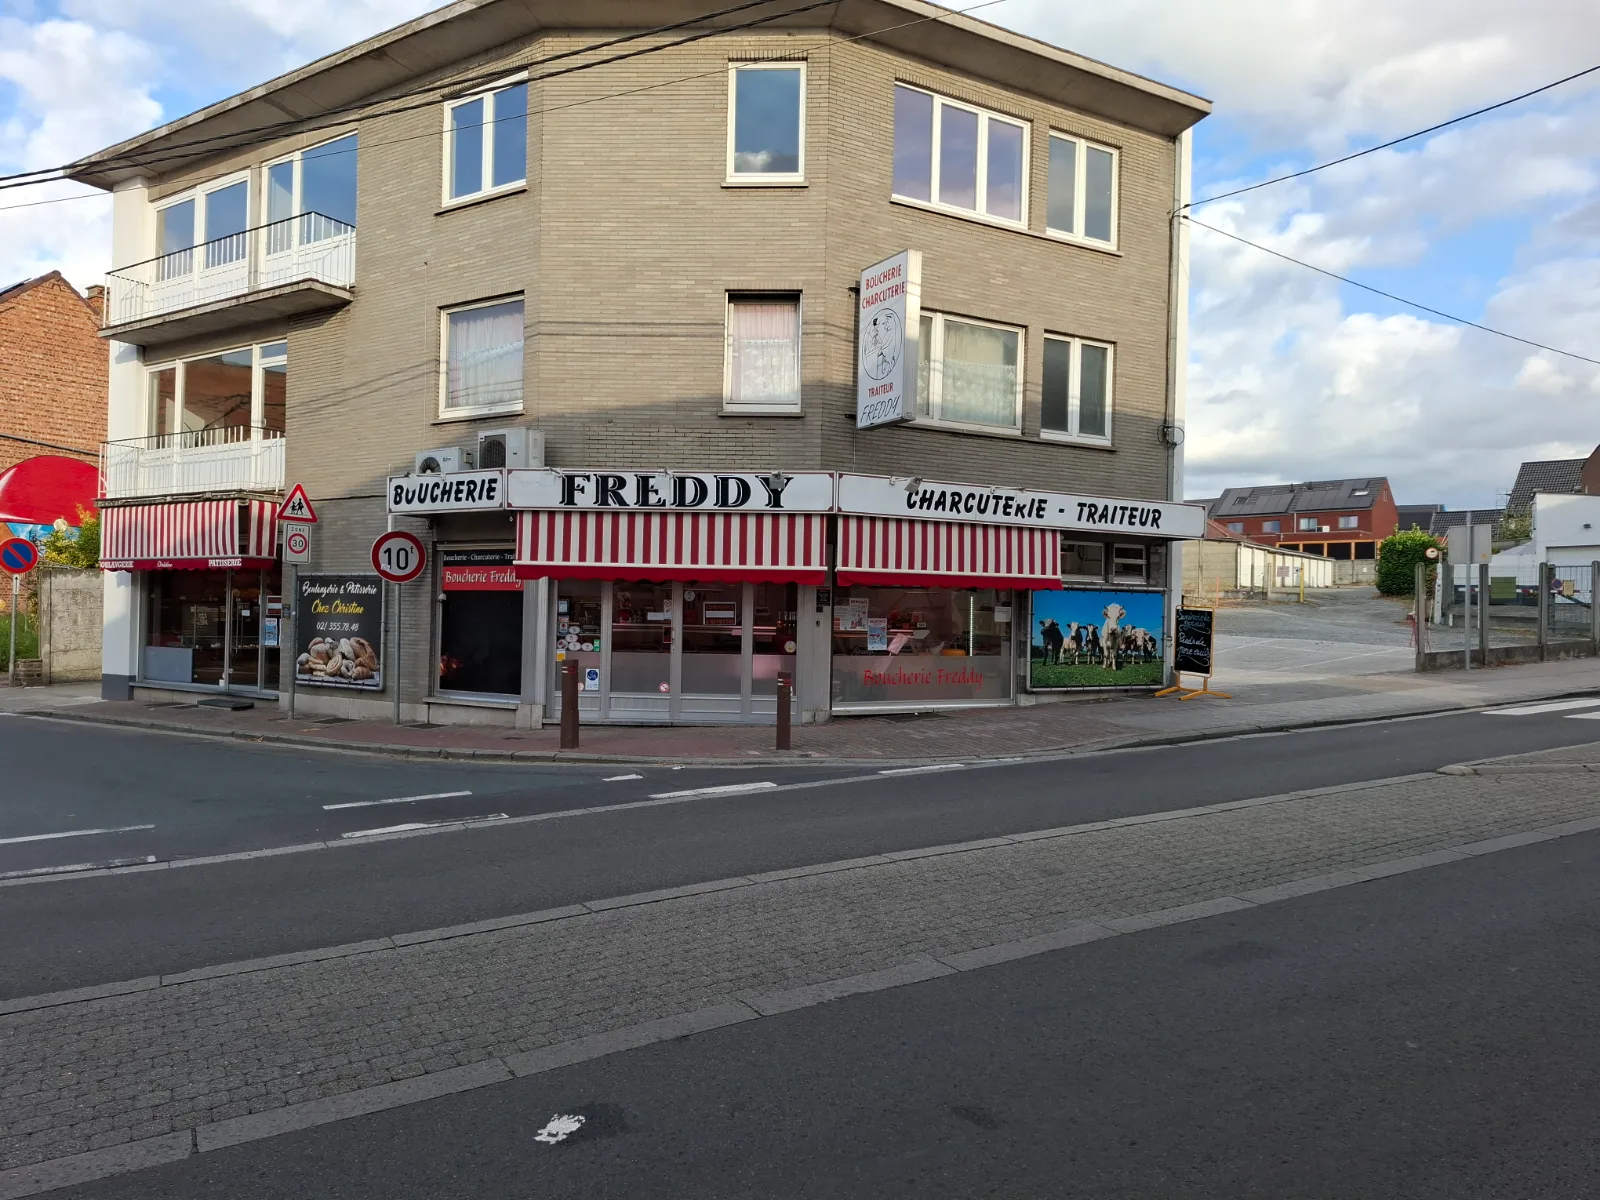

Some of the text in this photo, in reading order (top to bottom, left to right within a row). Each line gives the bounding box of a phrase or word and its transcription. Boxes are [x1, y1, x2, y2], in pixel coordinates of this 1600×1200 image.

[865, 264, 902, 291] BOUCHERIE
[861, 280, 906, 310] CHARCUTERIE
[868, 381, 894, 398] TRAITEUR
[860, 395, 901, 424] FREDDY
[393, 478, 498, 506] BOUCHERIE
[559, 472, 795, 508] FREDDY
[906, 488, 1048, 520] CHARCUTERIE
[1076, 502, 1162, 530] TRAITEUR
[291, 539, 304, 548] 30
[100, 560, 134, 569] OULANGERIE
[208, 558, 242, 567] PATISSERIE
[470, 553, 501, 561] Charcuterie
[445, 568, 488, 583] Boucherie
[301, 580, 339, 598] Boulangerie
[311, 598, 365, 615] Chez Christine
[863, 665, 984, 692] Boucherie Freddy
